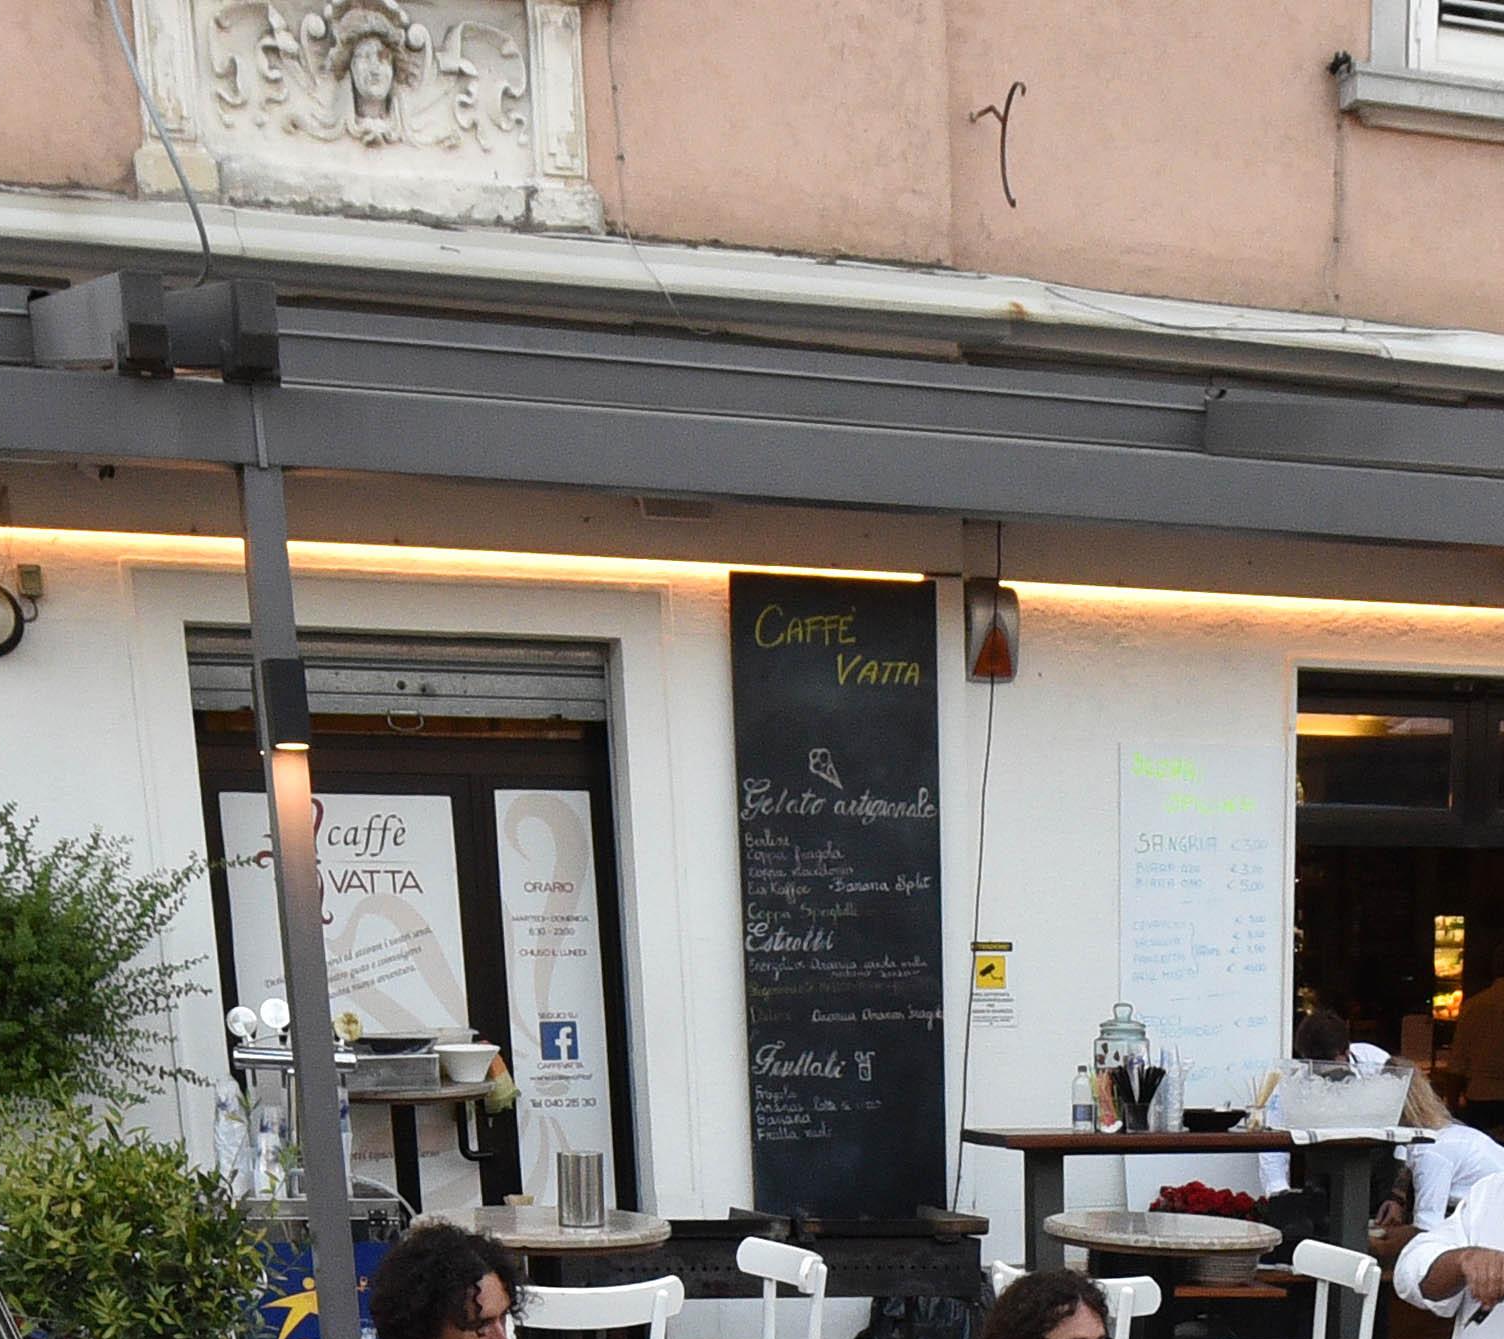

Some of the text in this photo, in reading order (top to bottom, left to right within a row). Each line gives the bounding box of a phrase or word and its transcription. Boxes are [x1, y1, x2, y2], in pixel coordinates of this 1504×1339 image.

[837, 653, 921, 686] VATTA
[741, 778, 826, 820] Gelato
[327, 814, 406, 857] caffè
[1136, 833, 1217, 853] SANGRIA
[328, 869, 424, 894] VATTA
[524, 882, 574, 893] ORARIO
[752, 1041, 846, 1078] Frullati
